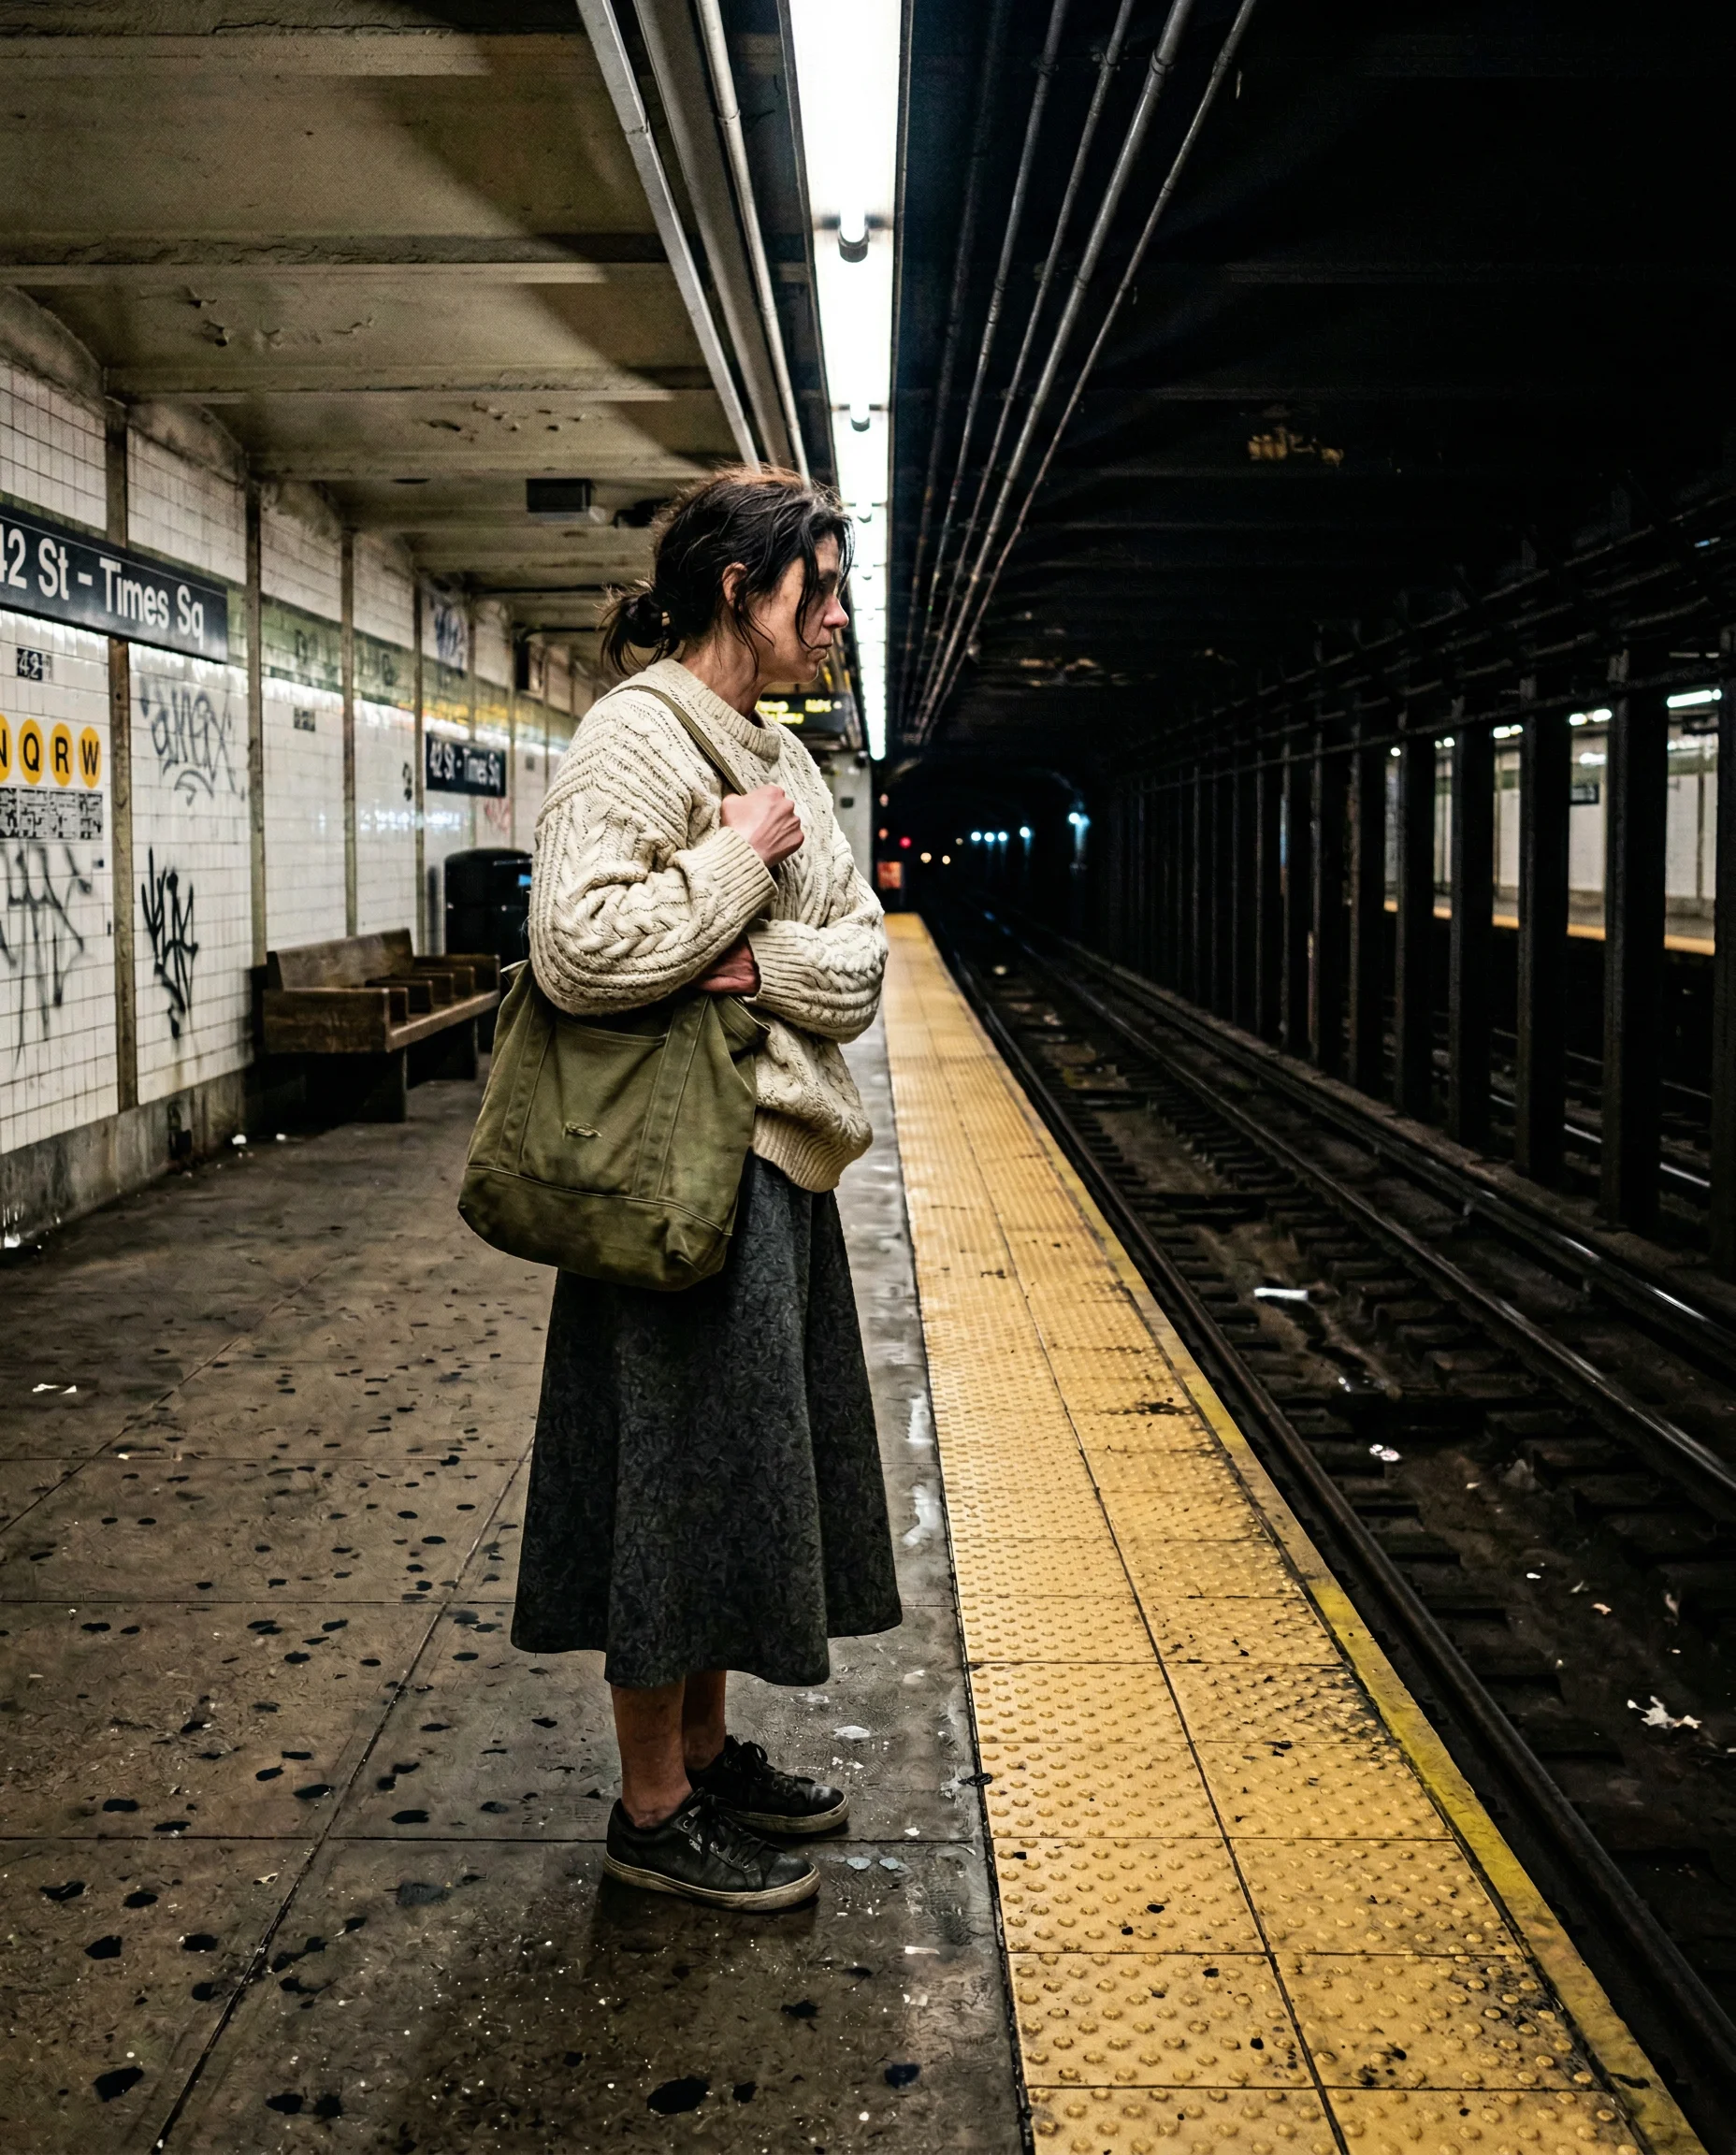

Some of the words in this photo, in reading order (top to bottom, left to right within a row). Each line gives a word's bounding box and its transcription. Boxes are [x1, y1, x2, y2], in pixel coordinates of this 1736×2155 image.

[38, 538, 69, 600] St
[78, 572, 93, 586] -
[99, 557, 169, 629] Times
[177, 585, 204, 651] Sq
[23, 732, 39, 772] Q
[55, 736, 69, 774] R
[81, 739, 99, 776] W
